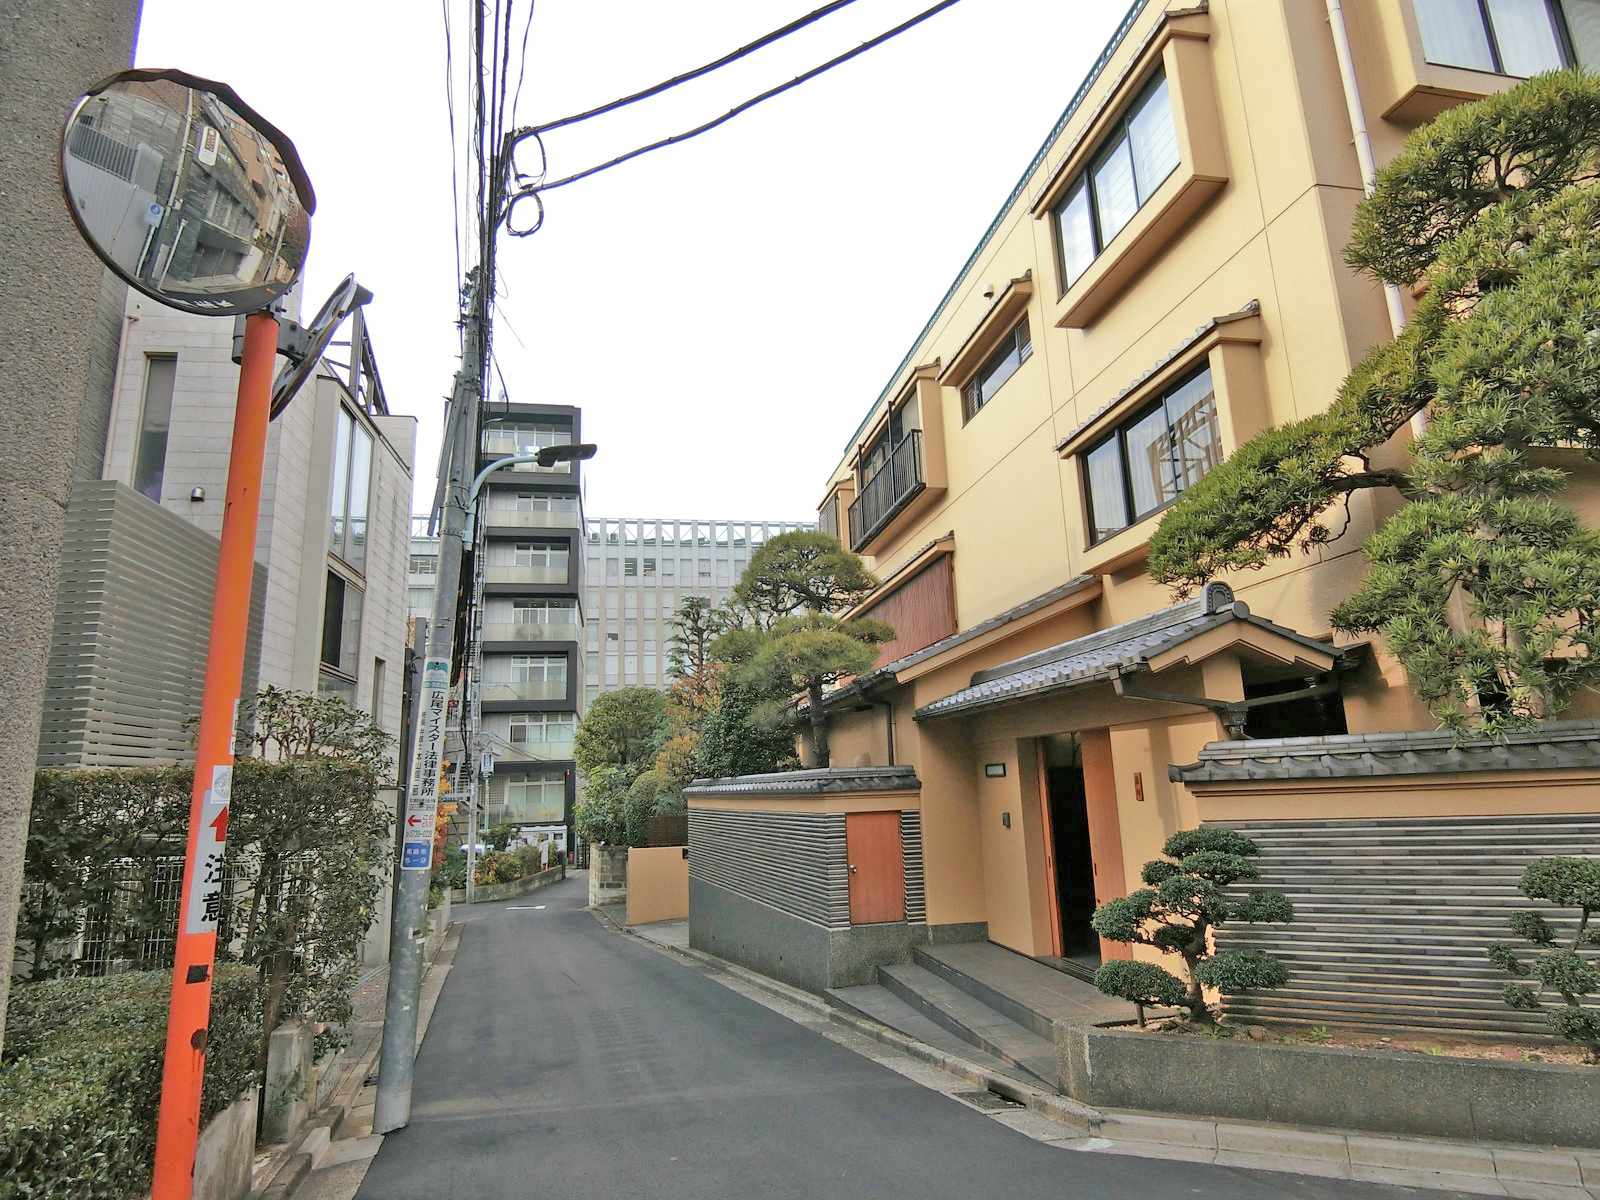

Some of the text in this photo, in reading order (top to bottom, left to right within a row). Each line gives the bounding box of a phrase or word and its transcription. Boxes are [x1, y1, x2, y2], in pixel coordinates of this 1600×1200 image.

[420, 690, 445, 796] 広尾マイスター法律事務所
[201, 853, 224, 922] 注意
